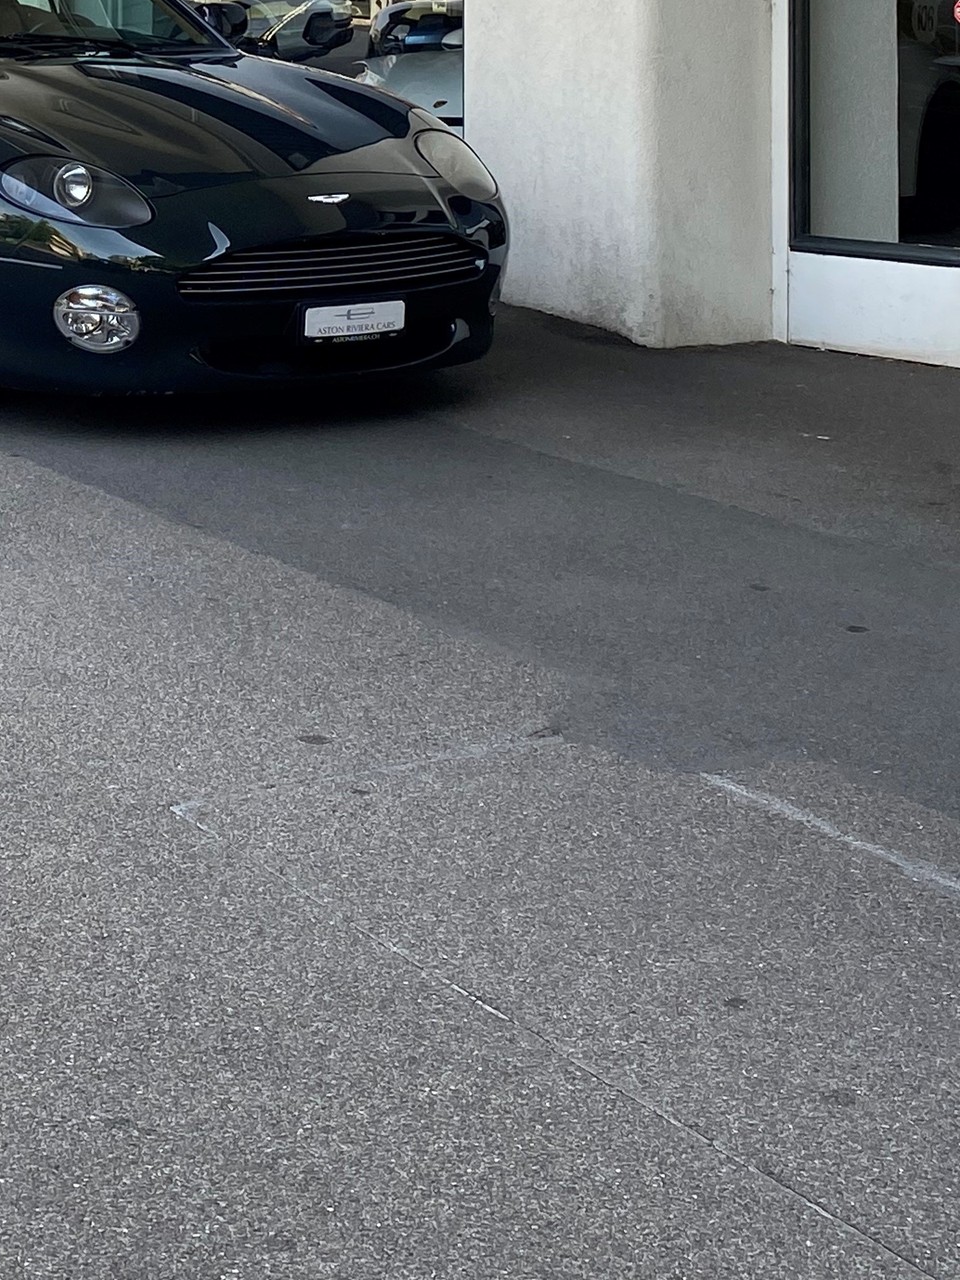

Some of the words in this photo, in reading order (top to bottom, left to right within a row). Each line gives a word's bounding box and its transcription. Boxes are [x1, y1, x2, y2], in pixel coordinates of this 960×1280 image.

[317, 325, 344, 335] ASTON
[346, 323, 375, 333] RIVIERA
[376, 321, 396, 330] CARS
